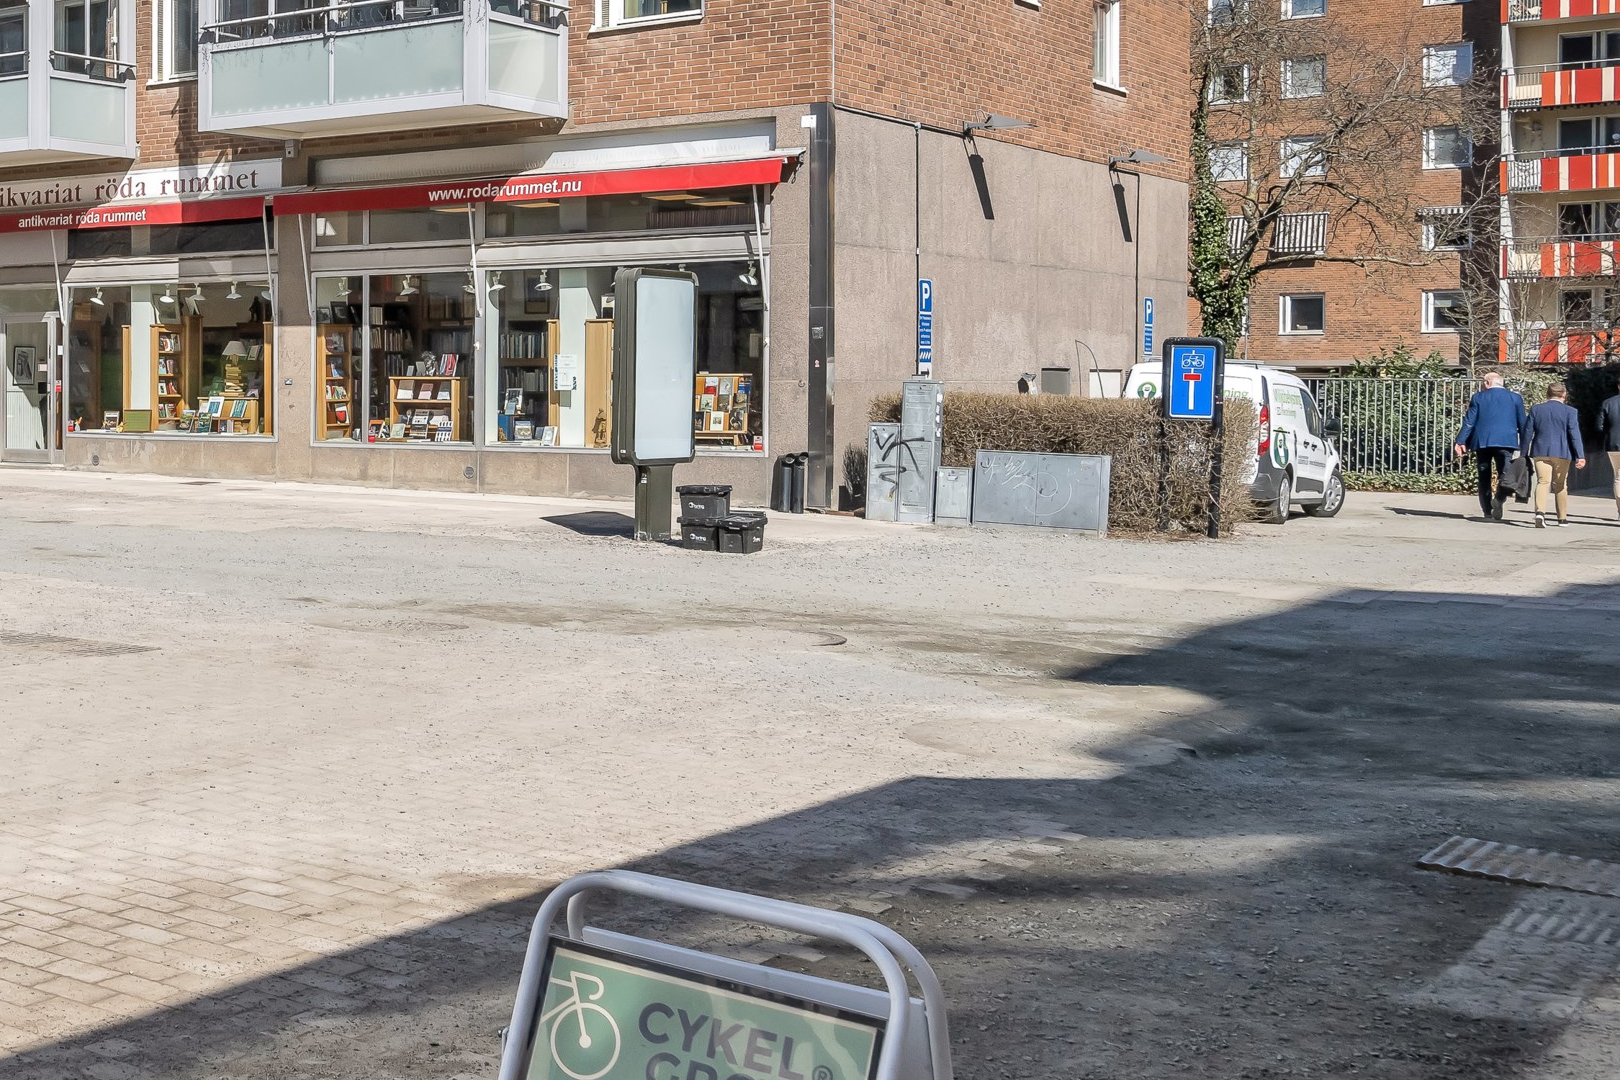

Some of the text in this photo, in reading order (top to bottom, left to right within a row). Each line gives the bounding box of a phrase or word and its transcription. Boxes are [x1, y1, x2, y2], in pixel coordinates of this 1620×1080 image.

[94, 177, 146, 201] röda
[160, 169, 259, 195] rummet
[428, 179, 582, 202] www.rodarummet.nu
[18, 208, 147, 228] antikvariat röda rummet
[922, 282, 930, 310] P
[1146, 300, 1152, 323] P
[638, 1002, 805, 1080] CYKEL
